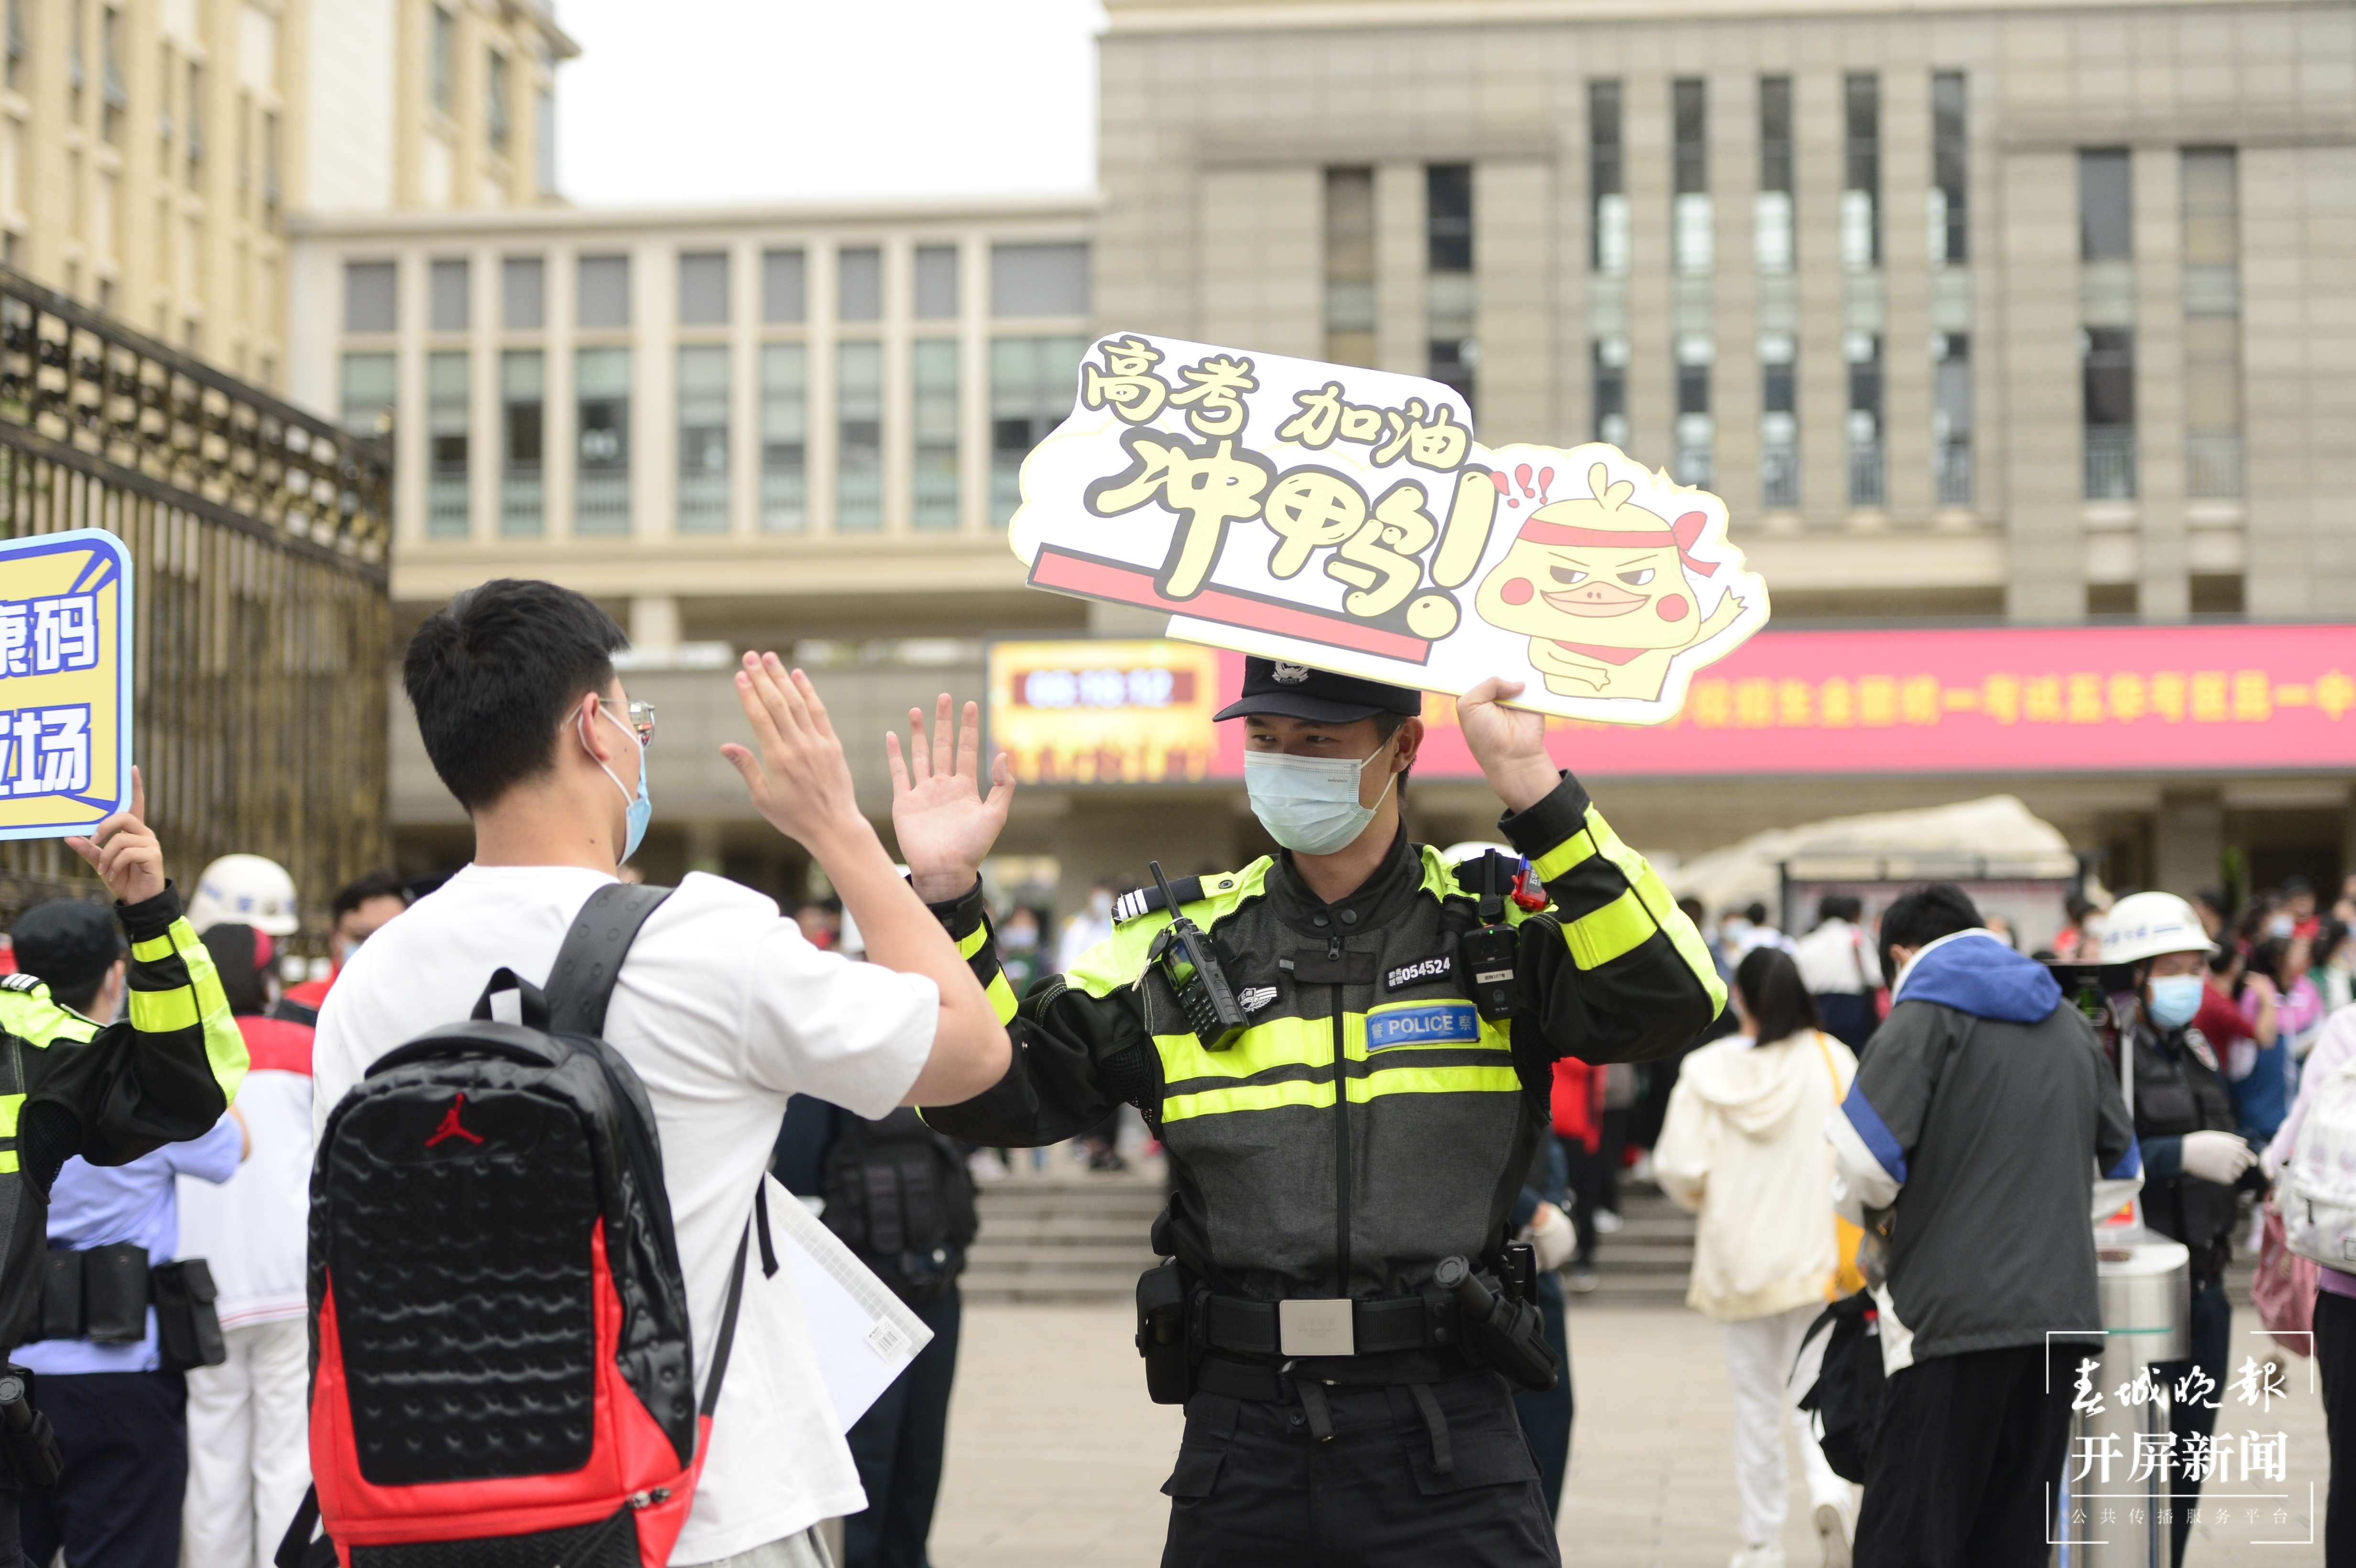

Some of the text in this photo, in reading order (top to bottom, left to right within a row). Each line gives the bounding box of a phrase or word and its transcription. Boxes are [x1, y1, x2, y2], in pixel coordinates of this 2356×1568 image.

[1085, 338, 1472, 471] 高考 加油
[1402, 957, 1451, 980] 054524
[1371, 1015, 1472, 1039] 警 POLICE 察
